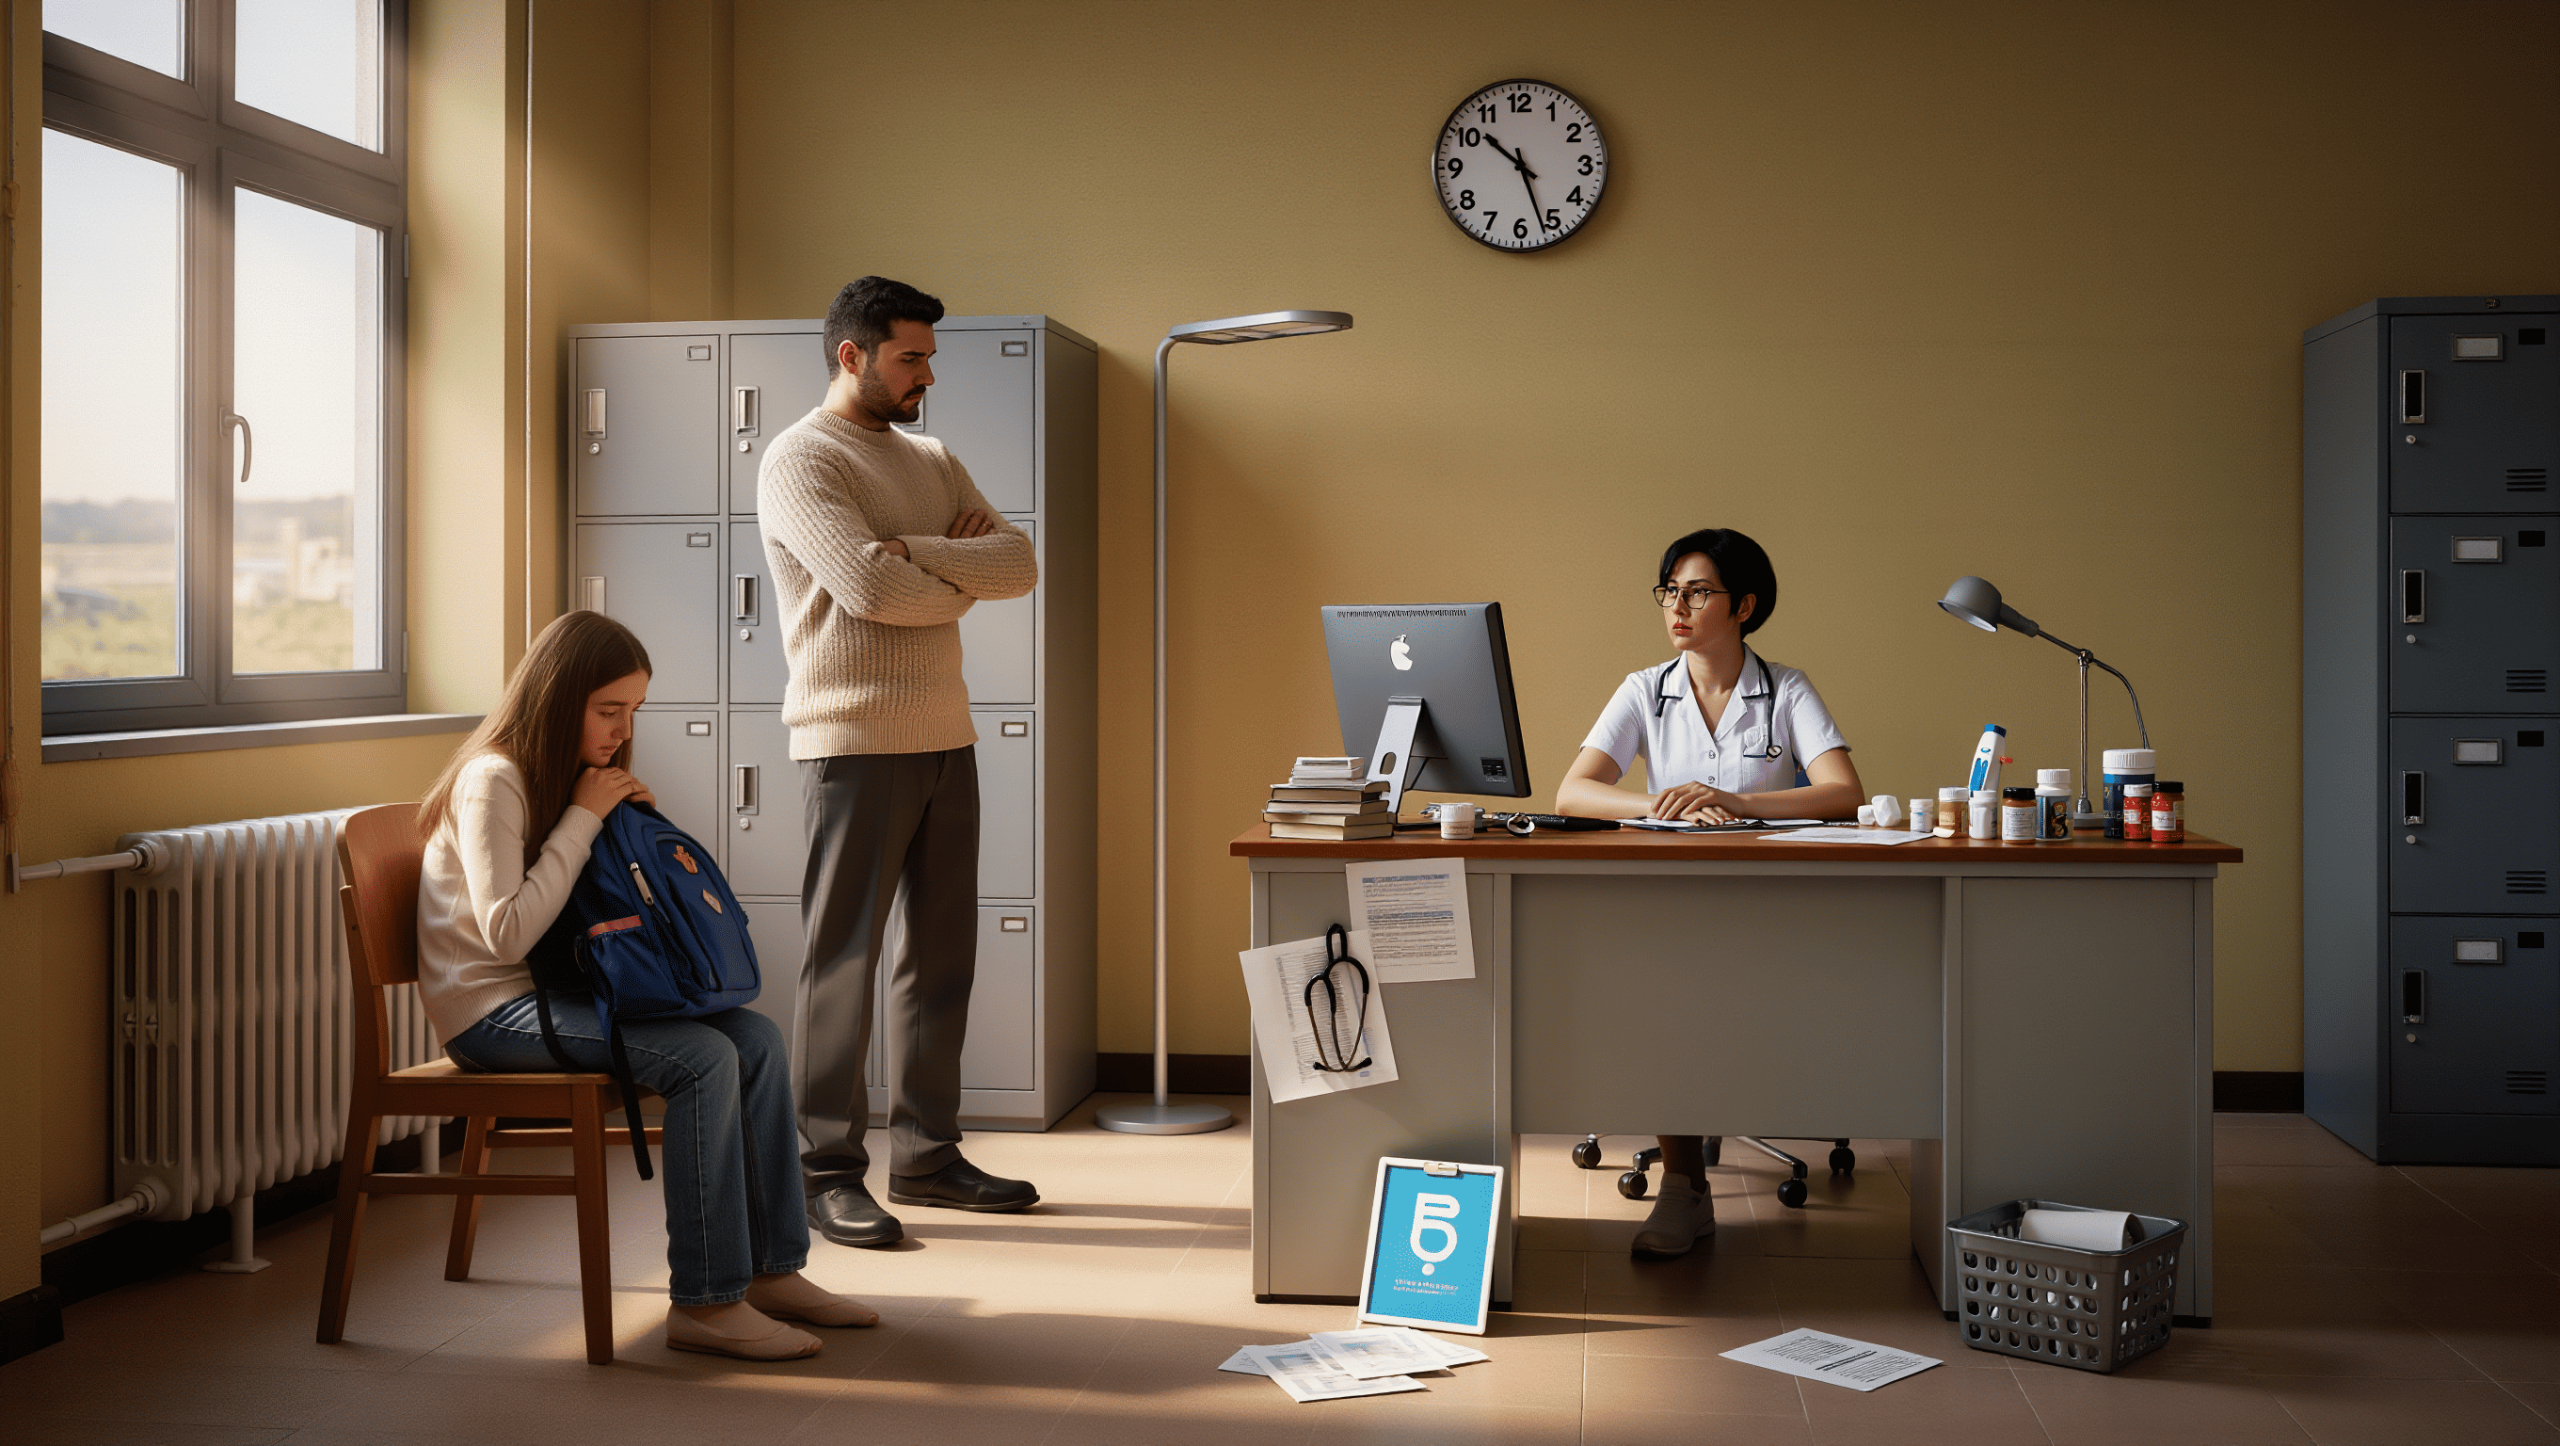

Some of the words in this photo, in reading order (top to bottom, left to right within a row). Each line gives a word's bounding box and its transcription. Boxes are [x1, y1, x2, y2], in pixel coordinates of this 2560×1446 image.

[1506, 92, 1533, 113] 12
[1545, 101, 1556, 122] 1
[1477, 103, 1497, 124] 11
[1458, 126, 1481, 147] 10
[1566, 122, 1582, 143] 2
[1447, 157, 1464, 179] 9
[1577, 154, 1594, 176] 3
[1459, 189, 1476, 210] 8
[1565, 185, 1585, 206] 4
[1483, 211, 1498, 231] 7
[1513, 217, 1528, 239] 6
[1544, 208, 1562, 230] 5
